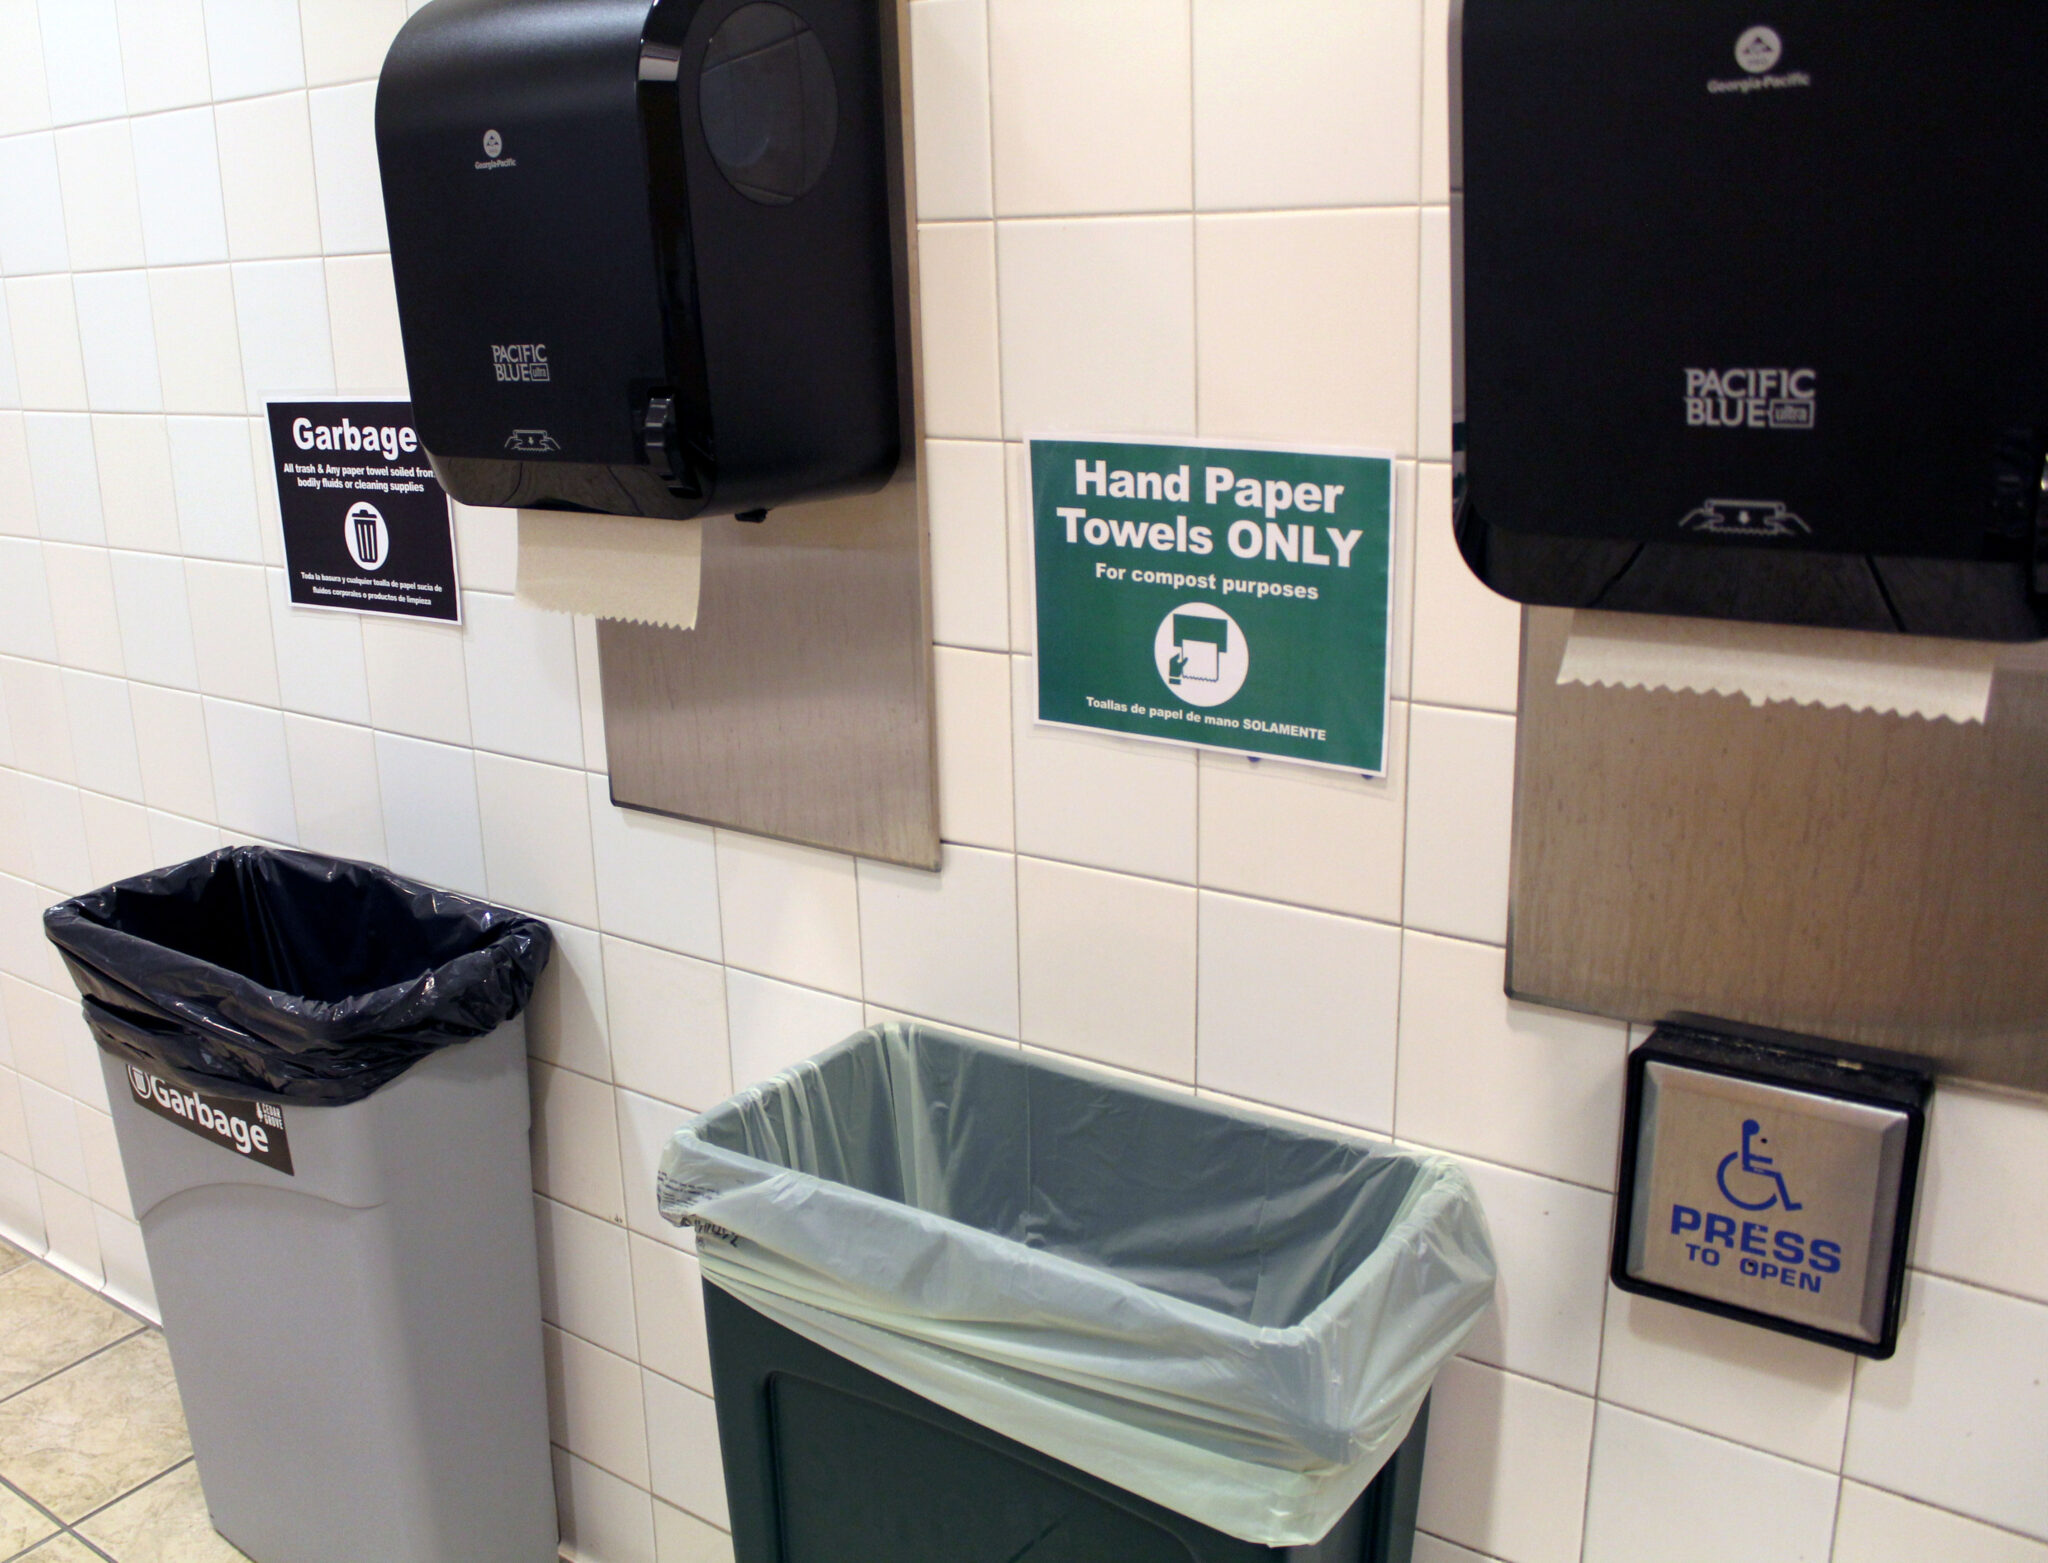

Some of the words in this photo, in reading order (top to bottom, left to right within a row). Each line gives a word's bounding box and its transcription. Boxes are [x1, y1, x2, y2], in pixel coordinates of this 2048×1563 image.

[490, 344, 548, 363] PACIFIC
[493, 363, 530, 382] BLUE
[1684, 368, 1816, 398] PACIFIC
[1684, 397, 1767, 427] BLUE
[1774, 405, 1808, 423] ultra
[292, 417, 418, 461] Garbage
[283, 463, 294, 473] All
[295, 463, 316, 474] trash
[317, 464, 324, 474] &
[325, 464, 340, 477] Any
[342, 466, 365, 477] paper
[366, 466, 389, 476] towel
[390, 466, 415, 477] soiled
[297, 477, 321, 490] bodily
[322, 478, 343, 488] fluids
[354, 479, 389, 493] cleaning
[390, 481, 424, 494] supplies
[1075, 459, 1190, 503] Hand
[1205, 466, 1345, 519] Paper
[1056, 507, 1214, 555] Towels
[1227, 520, 1363, 568] ONLY
[301, 572, 315, 580] Toda
[342, 576, 346, 584] y
[346, 577, 372, 587] cualquier
[373, 579, 390, 587] toalla
[391, 580, 399, 588] de
[399, 582, 416, 591] papel
[417, 583, 434, 592] sucia
[434, 584, 443, 592] de
[1095, 563, 1126, 581] For
[1131, 567, 1217, 591] compost
[1222, 576, 1319, 600] purposes
[332, 588, 362, 598] corporales
[367, 592, 397, 602] productos
[398, 594, 406, 603] de
[406, 595, 432, 606] limpieza
[1086, 696, 1128, 713] Toallas
[1130, 703, 1146, 715] de
[1149, 706, 1183, 721] papel
[1186, 710, 1201, 723] de
[1204, 715, 1240, 728] mano
[1243, 718, 1327, 741] SOLAMENTE
[150, 1075, 269, 1154] Garbage
[262, 1103, 281, 1119] CEDAR
[264, 1114, 284, 1130] GROVE
[1670, 1204, 1841, 1274] PRESS
[1685, 1243, 1720, 1267] TO
[1739, 1259, 1822, 1293] OPEN
